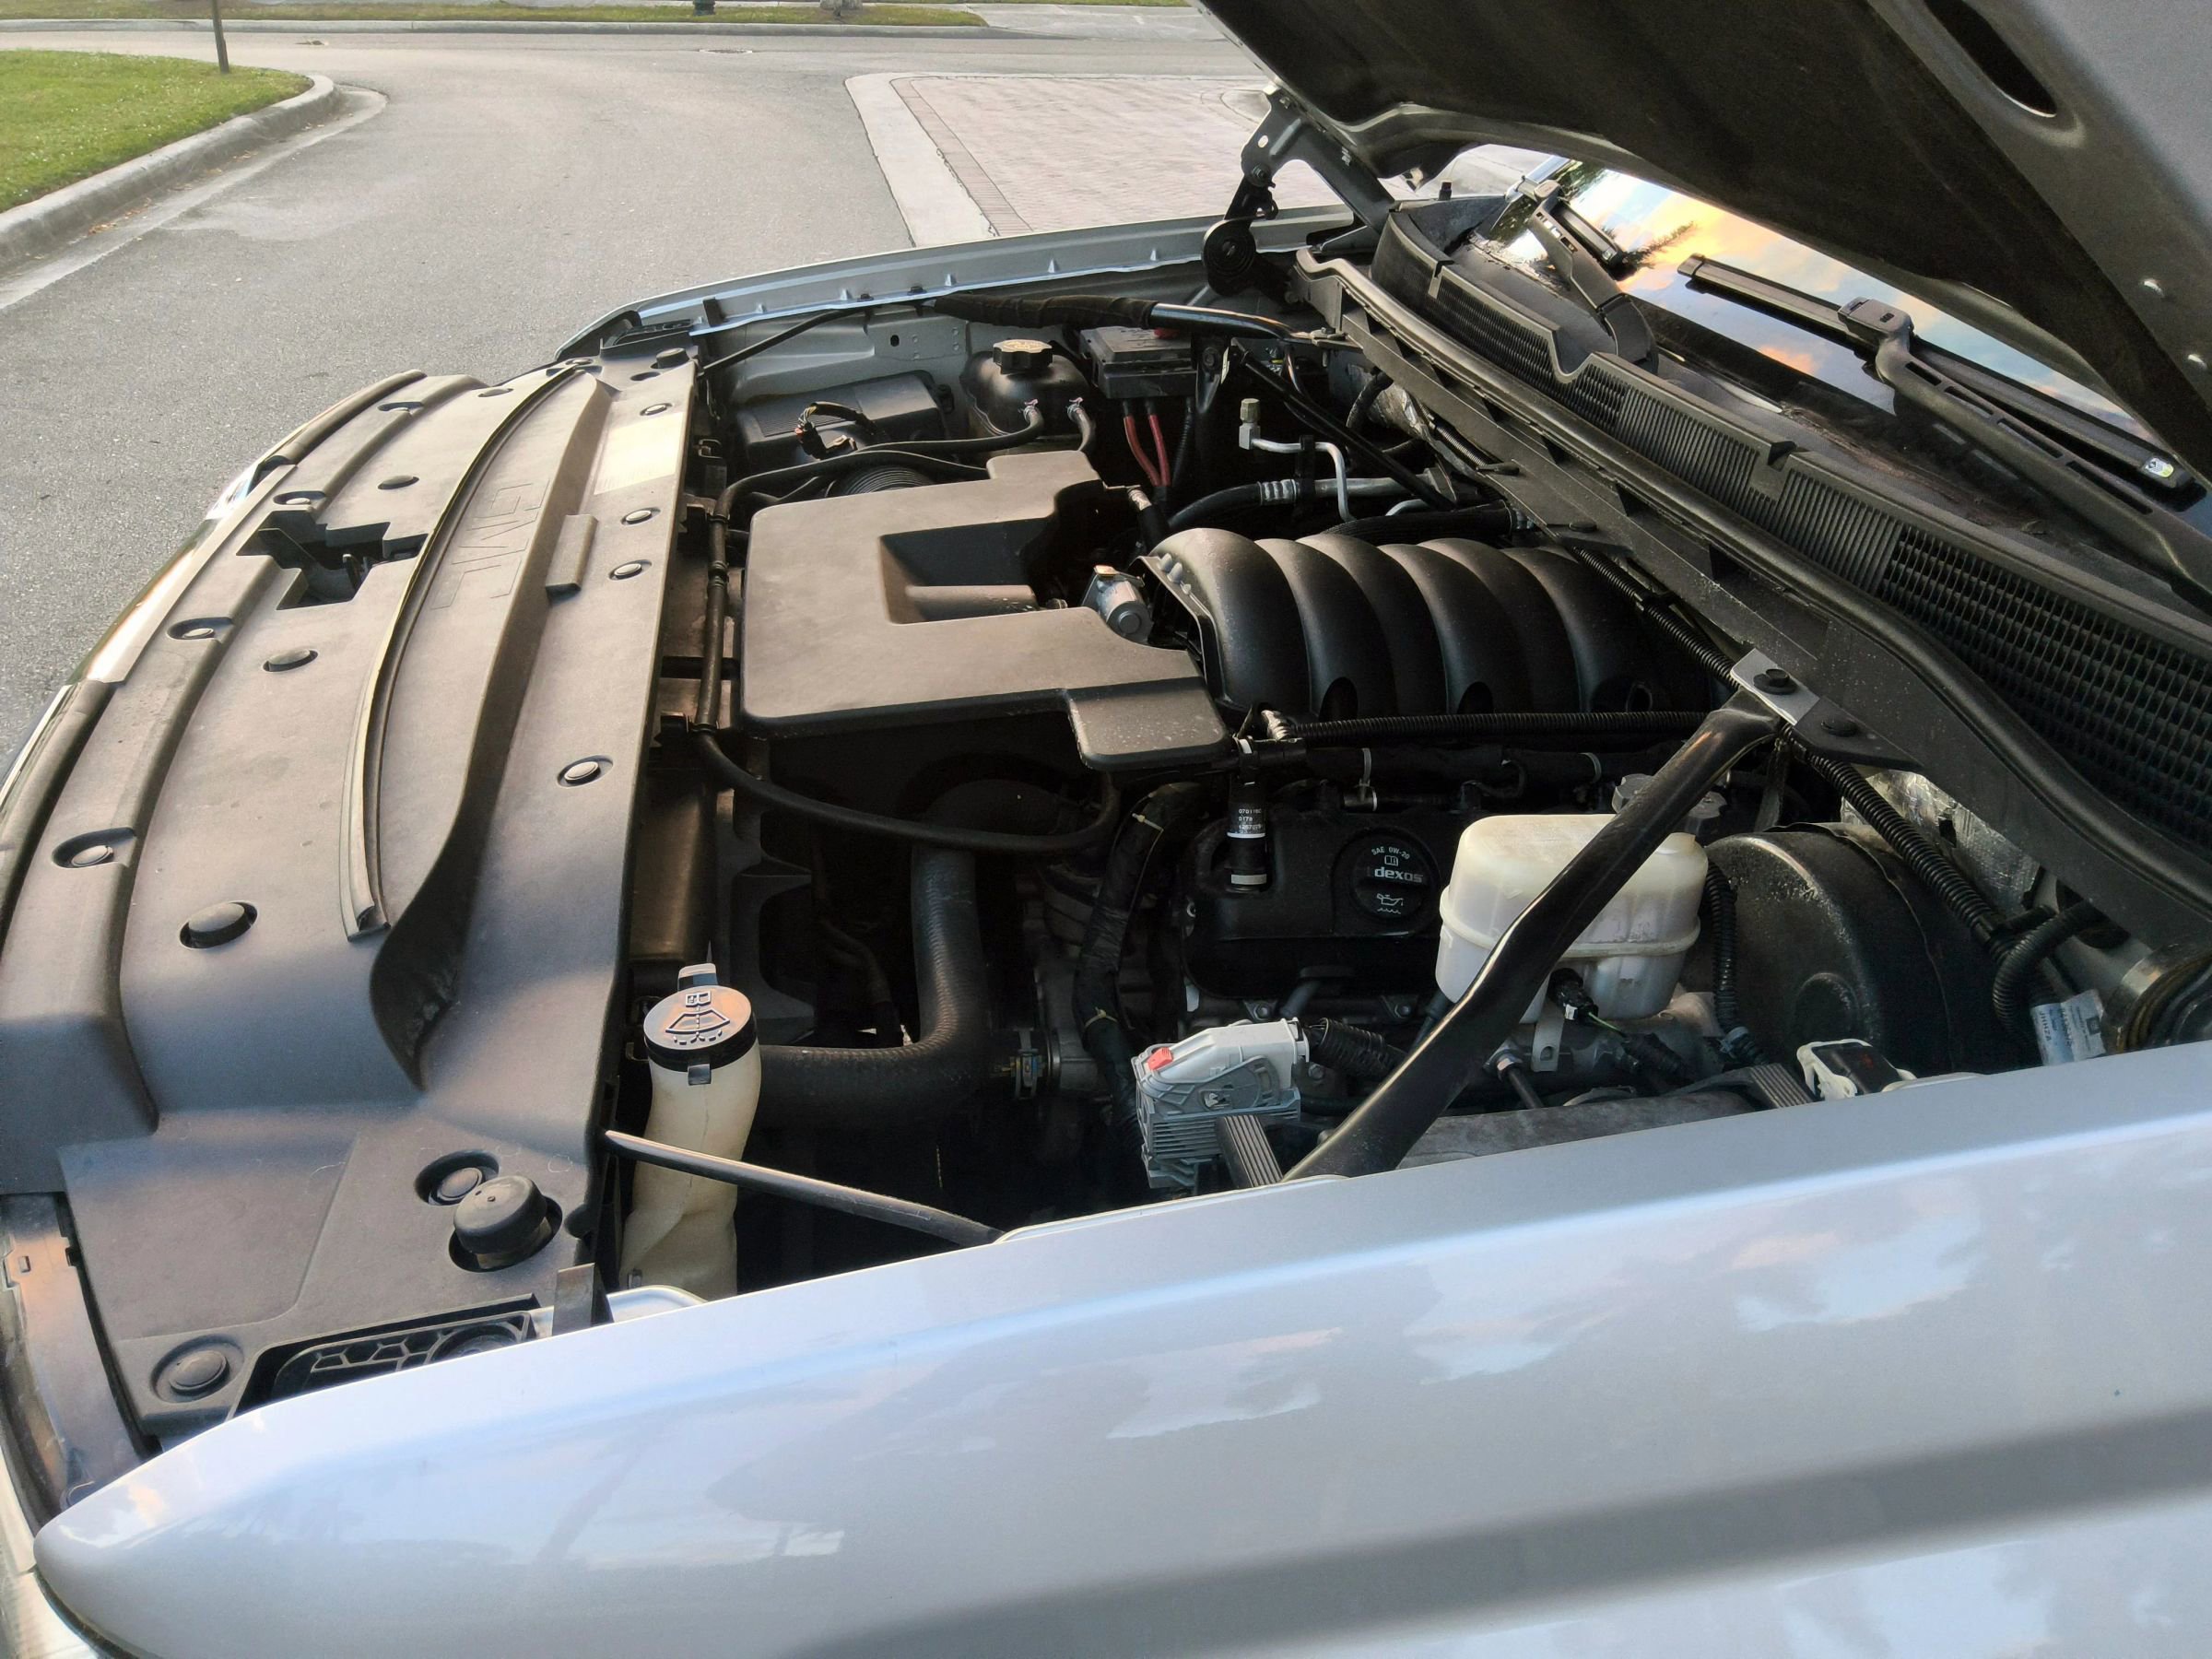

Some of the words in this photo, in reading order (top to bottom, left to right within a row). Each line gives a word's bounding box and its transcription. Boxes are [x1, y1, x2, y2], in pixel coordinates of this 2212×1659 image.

[430, 478, 550, 611] GMC
[1371, 846, 1385, 856] SAE
[1374, 866, 1424, 883] dexos
